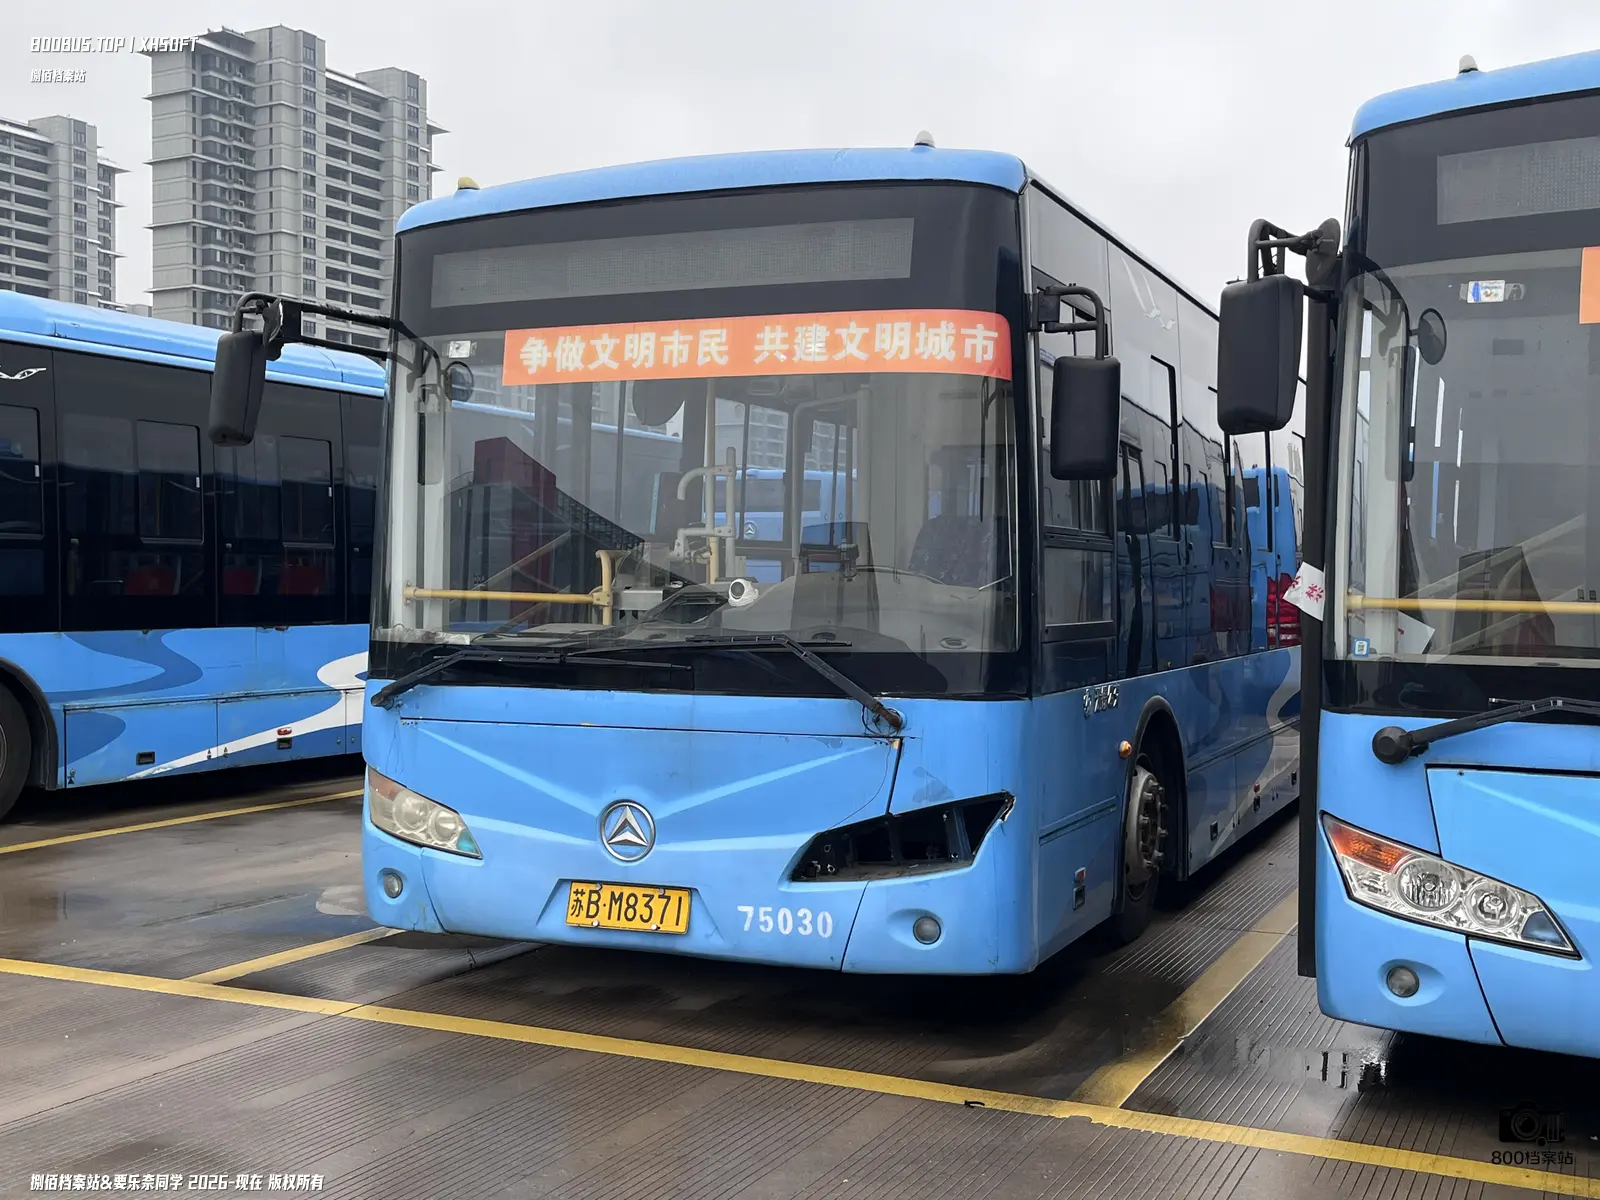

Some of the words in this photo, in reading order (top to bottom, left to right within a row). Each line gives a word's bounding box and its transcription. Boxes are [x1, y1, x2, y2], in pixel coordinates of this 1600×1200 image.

[519, 328, 730, 374] 争做文明市民
[753, 320, 999, 364] 共建文明城市
[736, 905, 834, 938] 75030
